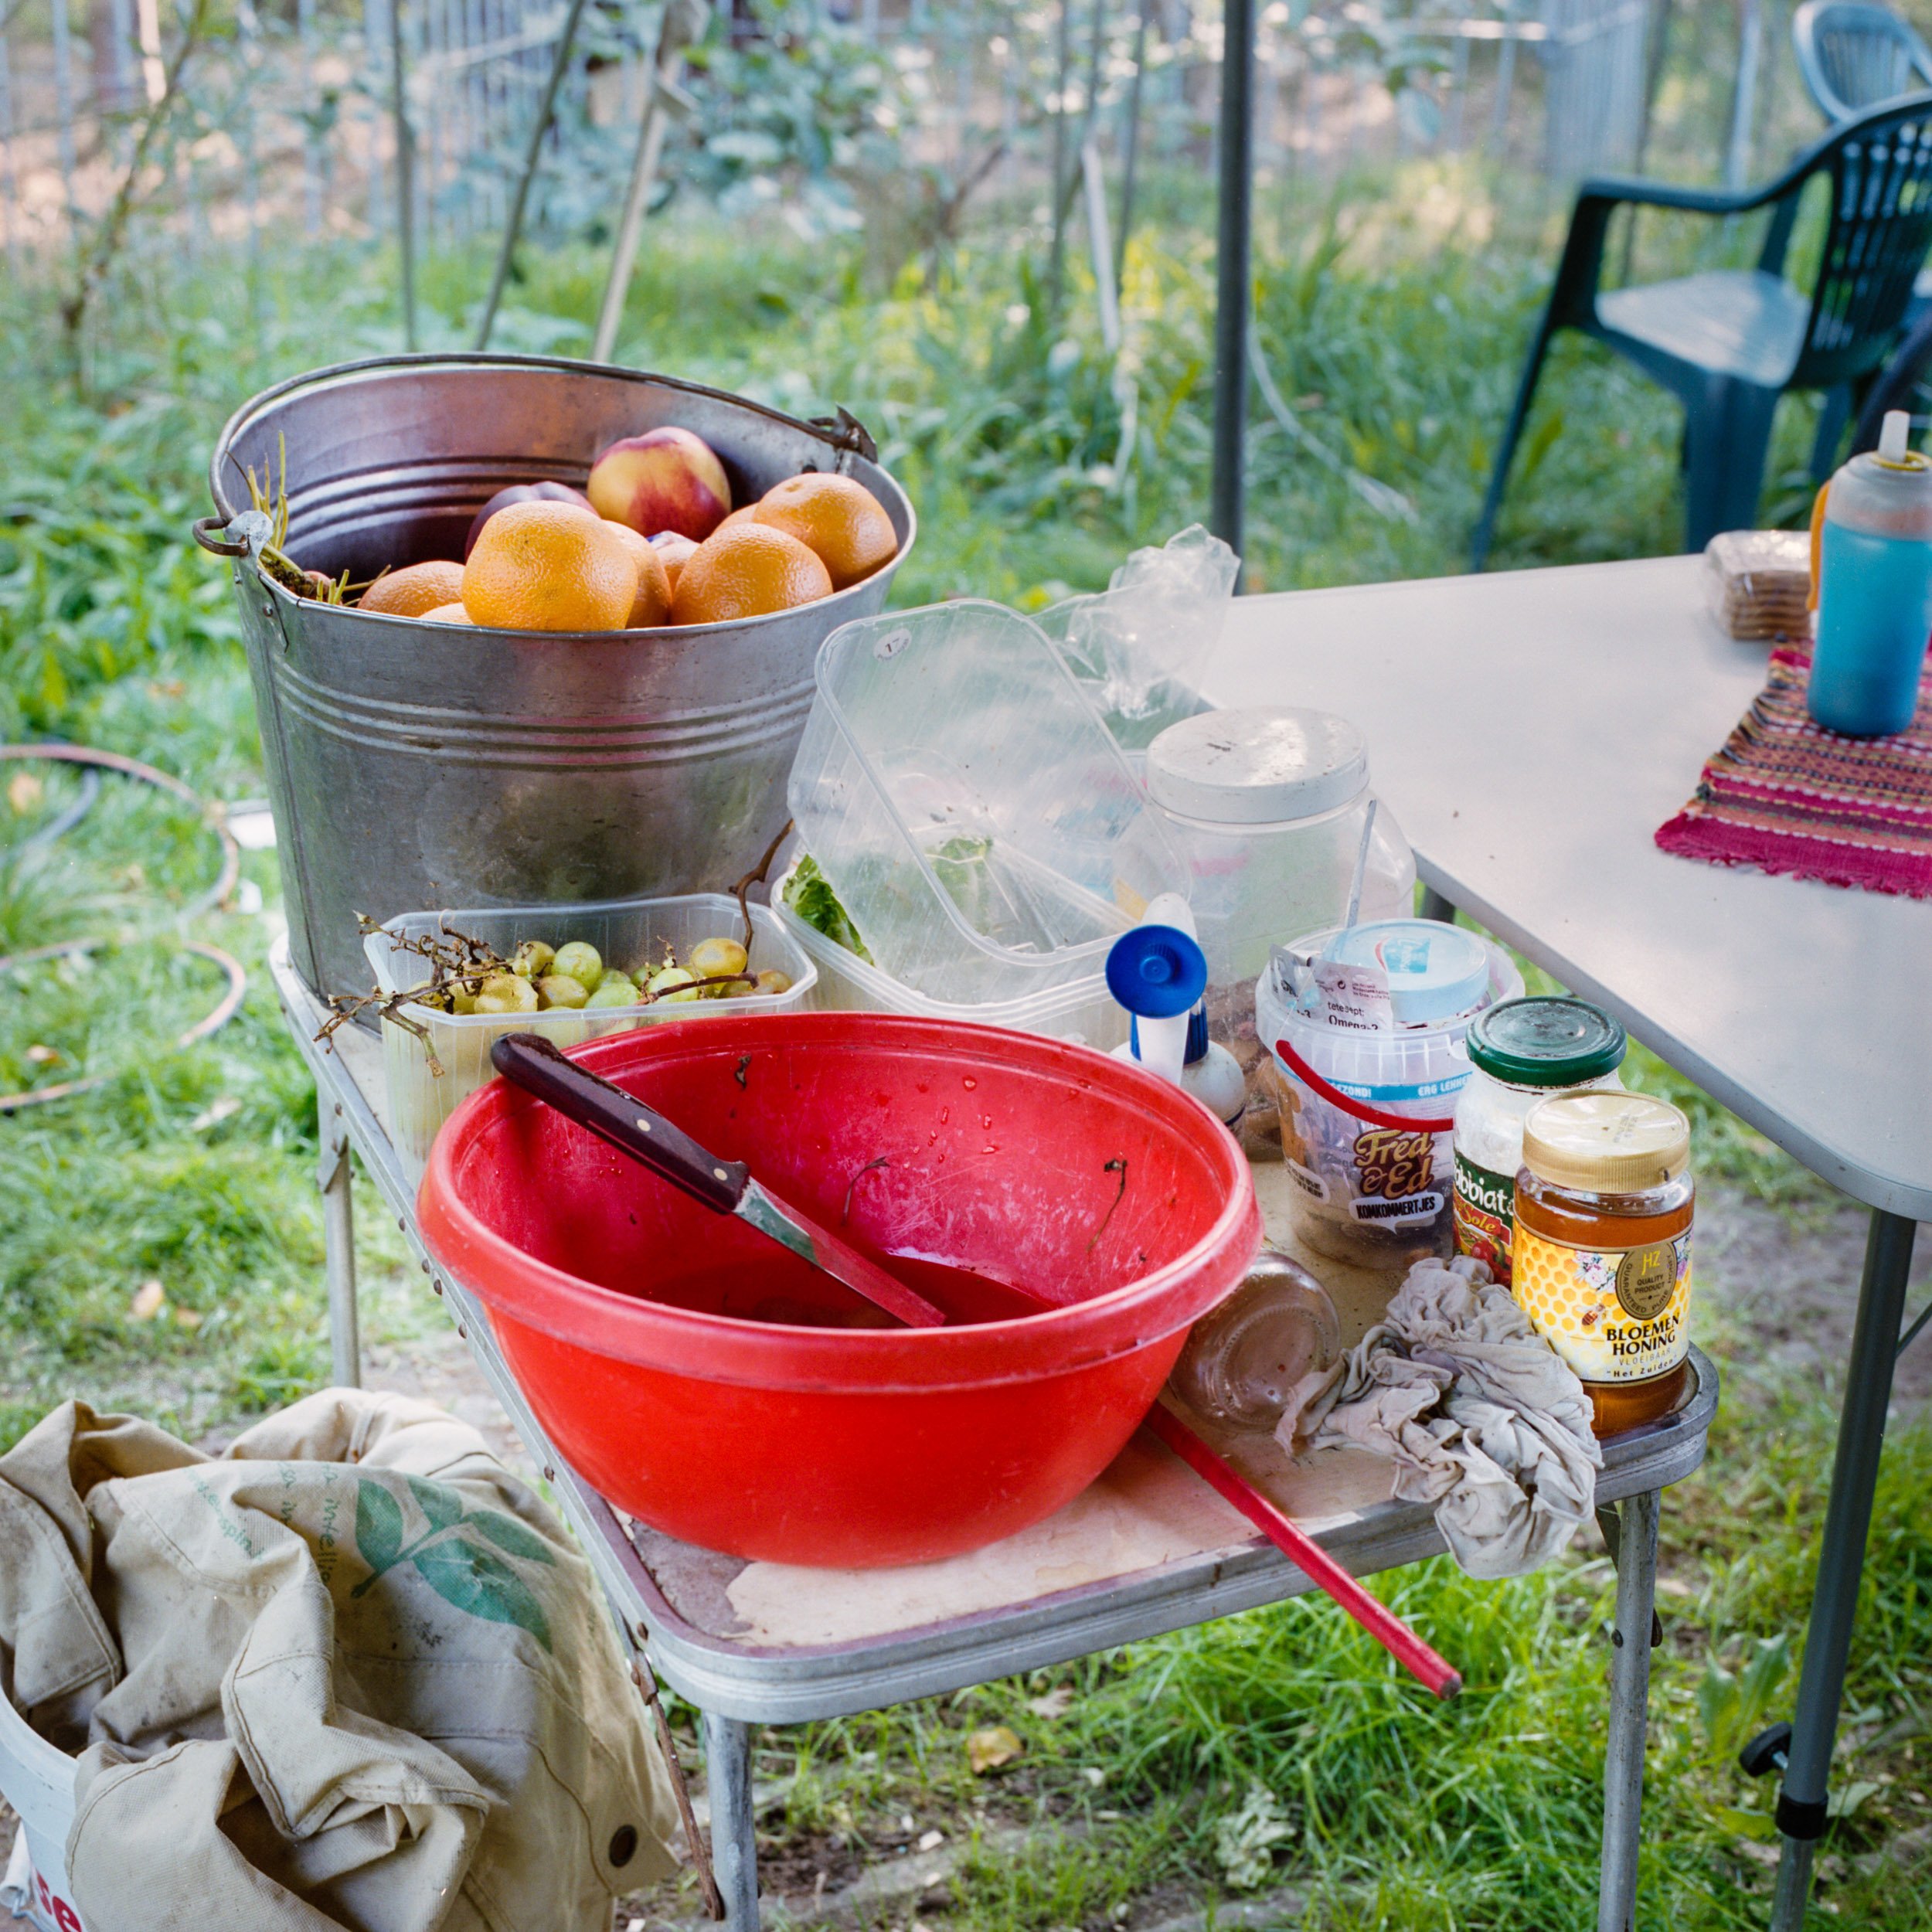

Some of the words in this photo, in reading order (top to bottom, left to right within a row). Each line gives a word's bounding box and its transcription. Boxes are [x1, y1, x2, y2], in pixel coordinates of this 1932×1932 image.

[1332, 1082, 1372, 1098] EZOND!
[1418, 1083, 1437, 1097] ERG
[1440, 1074, 1470, 1092] LEKKE
[1355, 1128, 1433, 1167] Fred
[1383, 1156, 1433, 1199] Ed
[1355, 1196, 1436, 1219] KOMKOMMERTJES
[1459, 1202, 1497, 1233] Sole
[1623, 1263, 1648, 1313] GUARANTEED
[1634, 1281, 1666, 1295] PRODUCT
[1636, 1274, 1665, 1287] QUALITY
[1607, 1311, 1681, 1342] BLOEMEN
[1613, 1329, 1676, 1356] HONING
[1618, 1347, 1671, 1366] VLOEIBAAR
